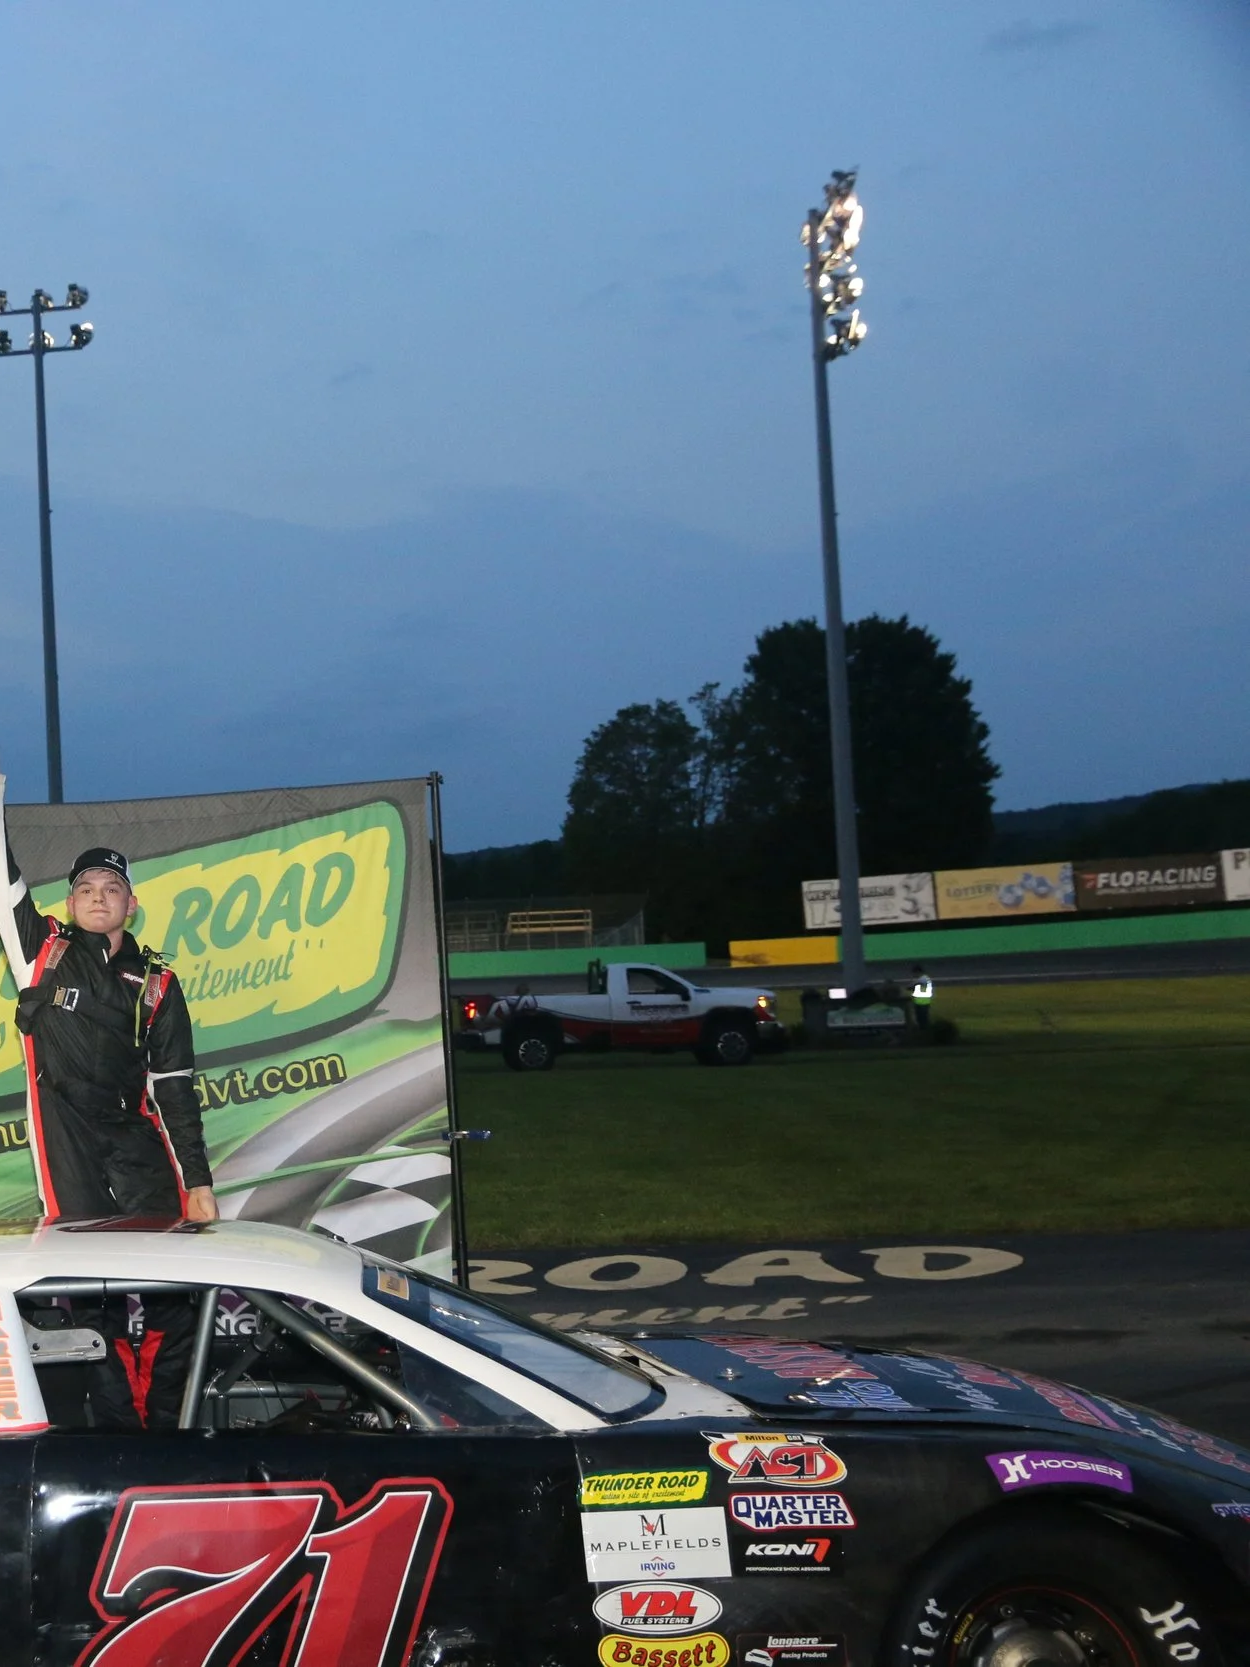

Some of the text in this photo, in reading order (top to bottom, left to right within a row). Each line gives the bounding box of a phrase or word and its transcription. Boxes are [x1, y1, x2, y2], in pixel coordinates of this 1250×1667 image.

[161, 852, 356, 962] ROAD
[1030, 1458, 1124, 1480] HOOSIER
[586, 1474, 699, 1492] THUNDER ROAD
[733, 1495, 841, 1518] QUARTER
[754, 1510, 849, 1528] MASTER
[590, 1537, 722, 1553] MAPLEFIELDS
[745, 1543, 816, 1556] KONI
[76, 1482, 450, 1667] 71
[640, 1561, 676, 1571] IRVING
[620, 1590, 698, 1617] VDL
[622, 1616, 690, 1625] FUEL SYSTEMS
[612, 1640, 717, 1667] Bassett
[781, 1651, 828, 1660] Racing Products
